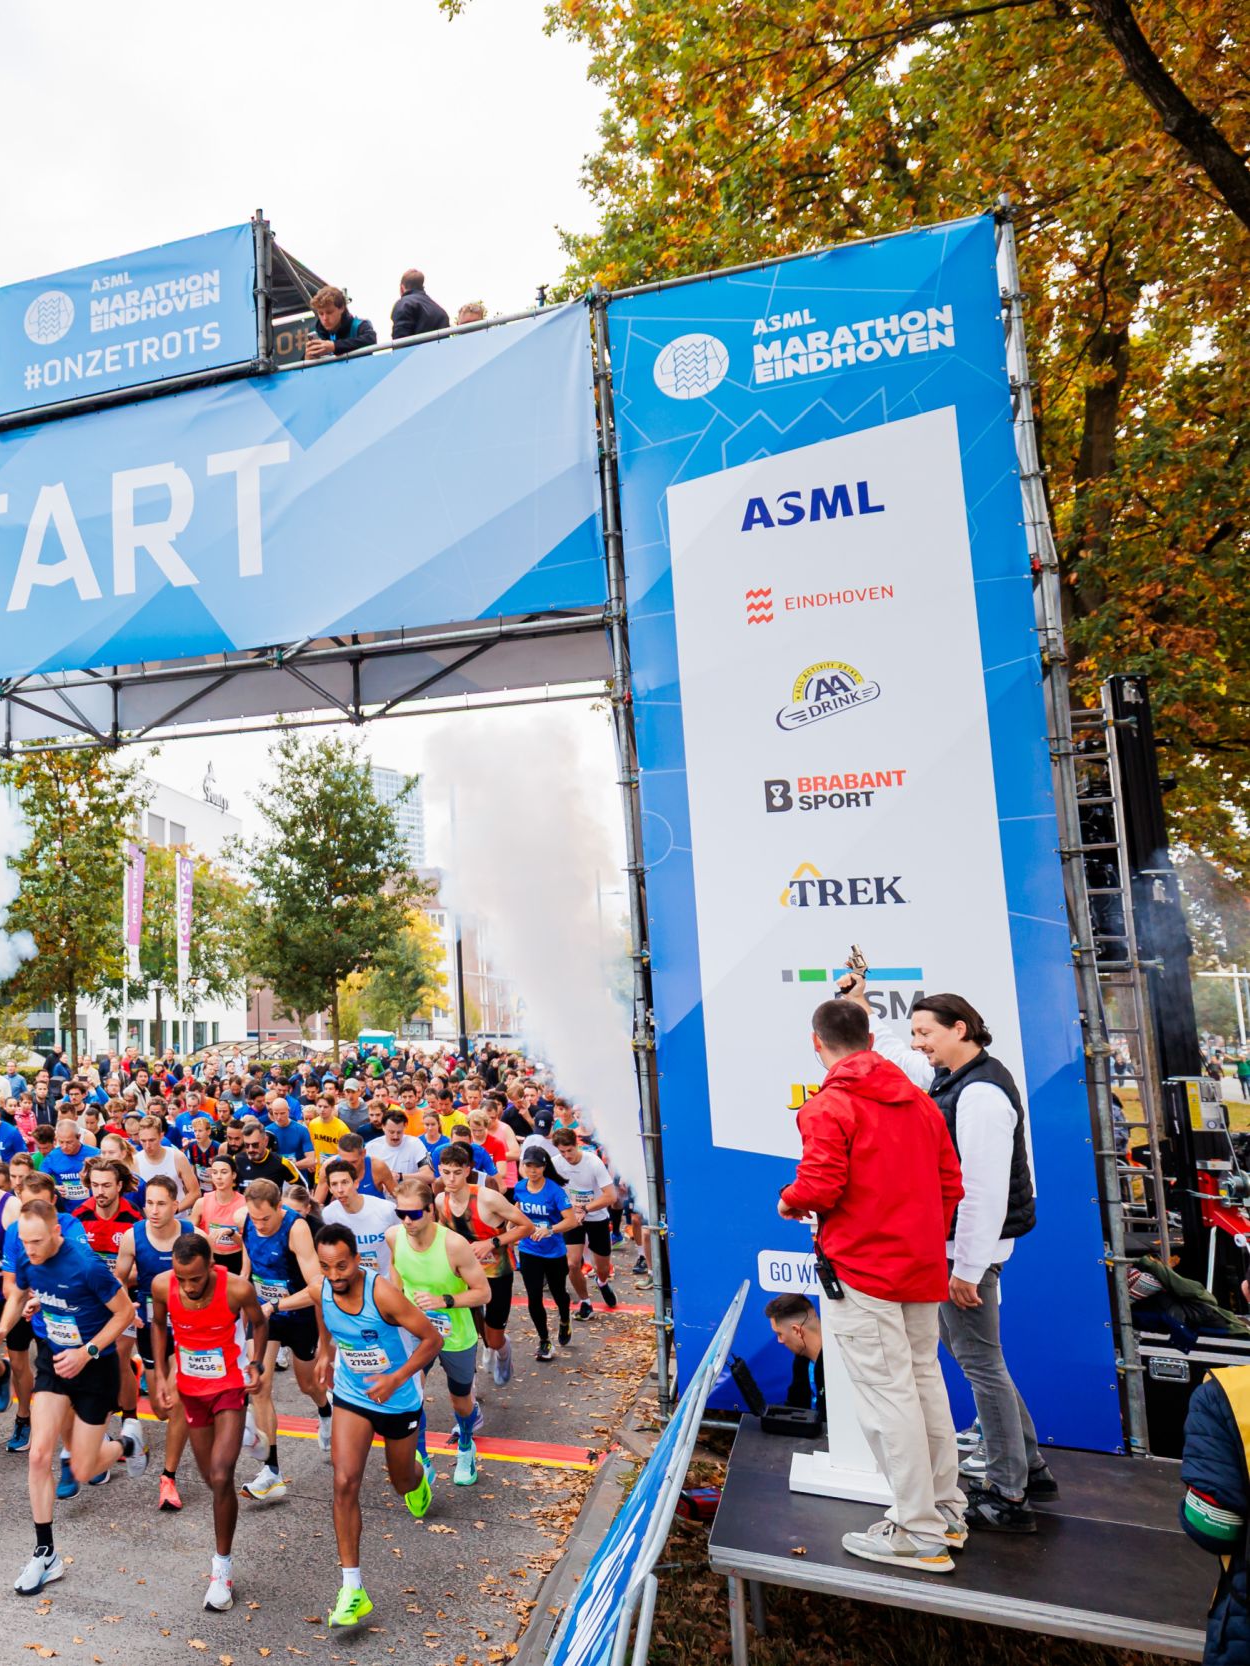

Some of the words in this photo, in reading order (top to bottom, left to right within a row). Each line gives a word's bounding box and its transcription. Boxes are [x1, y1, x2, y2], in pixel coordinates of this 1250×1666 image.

[90, 269, 221, 317] MARATHON
[91, 271, 133, 293] ASML
[90, 286, 221, 333] EINDHOVEN
[752, 308, 816, 336] ASML
[753, 304, 954, 364] MARATHON
[24, 321, 222, 391] #ONZETROTS
[754, 326, 956, 384] EINDHOVEN
[741, 480, 886, 532] ASML
[785, 585, 894, 611] EINDHOVEN
[814, 675, 852, 702] AA
[808, 690, 862, 718] DRINK
[797, 769, 907, 793] BRABANT
[799, 791, 875, 811] SPORT
[789, 876, 908, 907] TREK
[835, 991, 925, 1020] SM
[770, 1262, 792, 1283] GO
